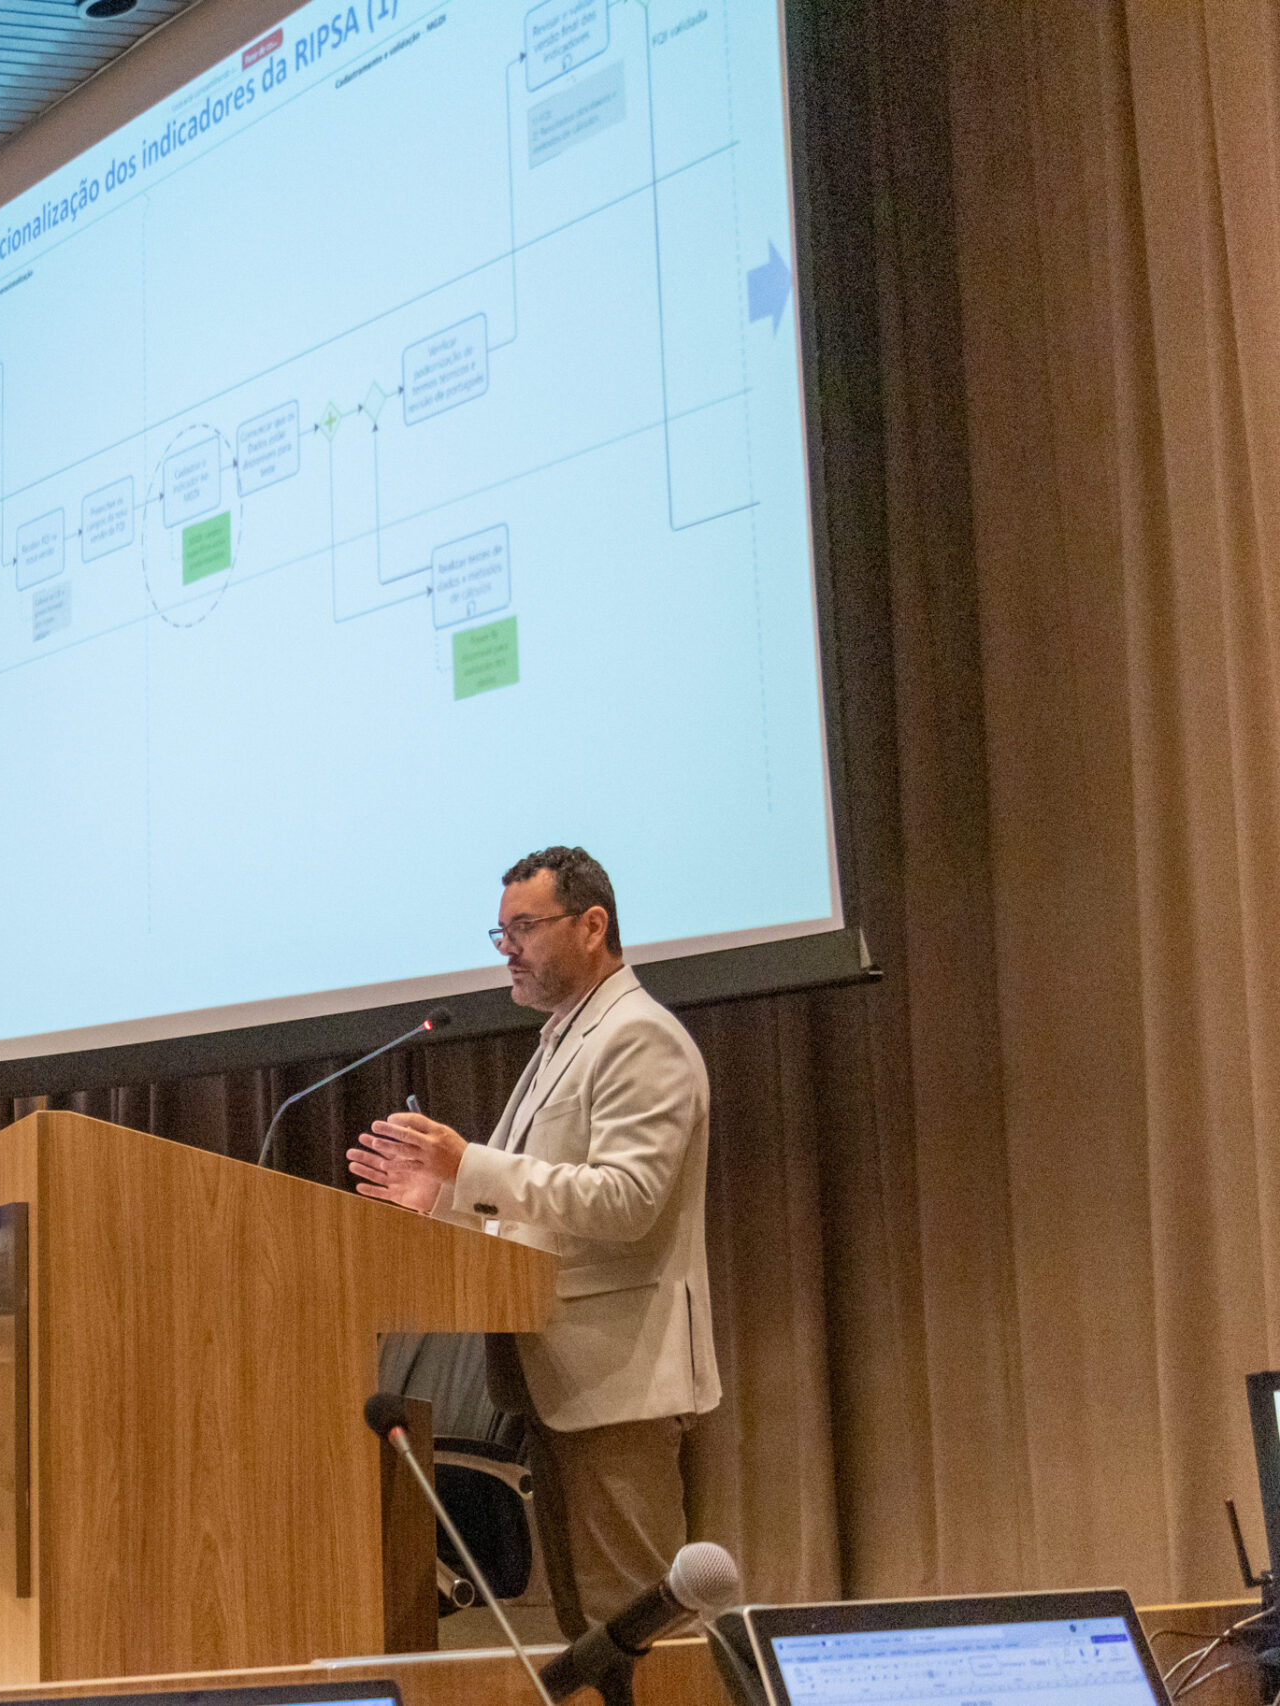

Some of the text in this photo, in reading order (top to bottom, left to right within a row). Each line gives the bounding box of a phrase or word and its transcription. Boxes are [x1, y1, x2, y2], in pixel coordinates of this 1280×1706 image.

[106, 155, 136, 192] dos
[142, 78, 255, 168] indicadores
[262, 56, 287, 92] da
[295, 6, 359, 71] RIPSA
